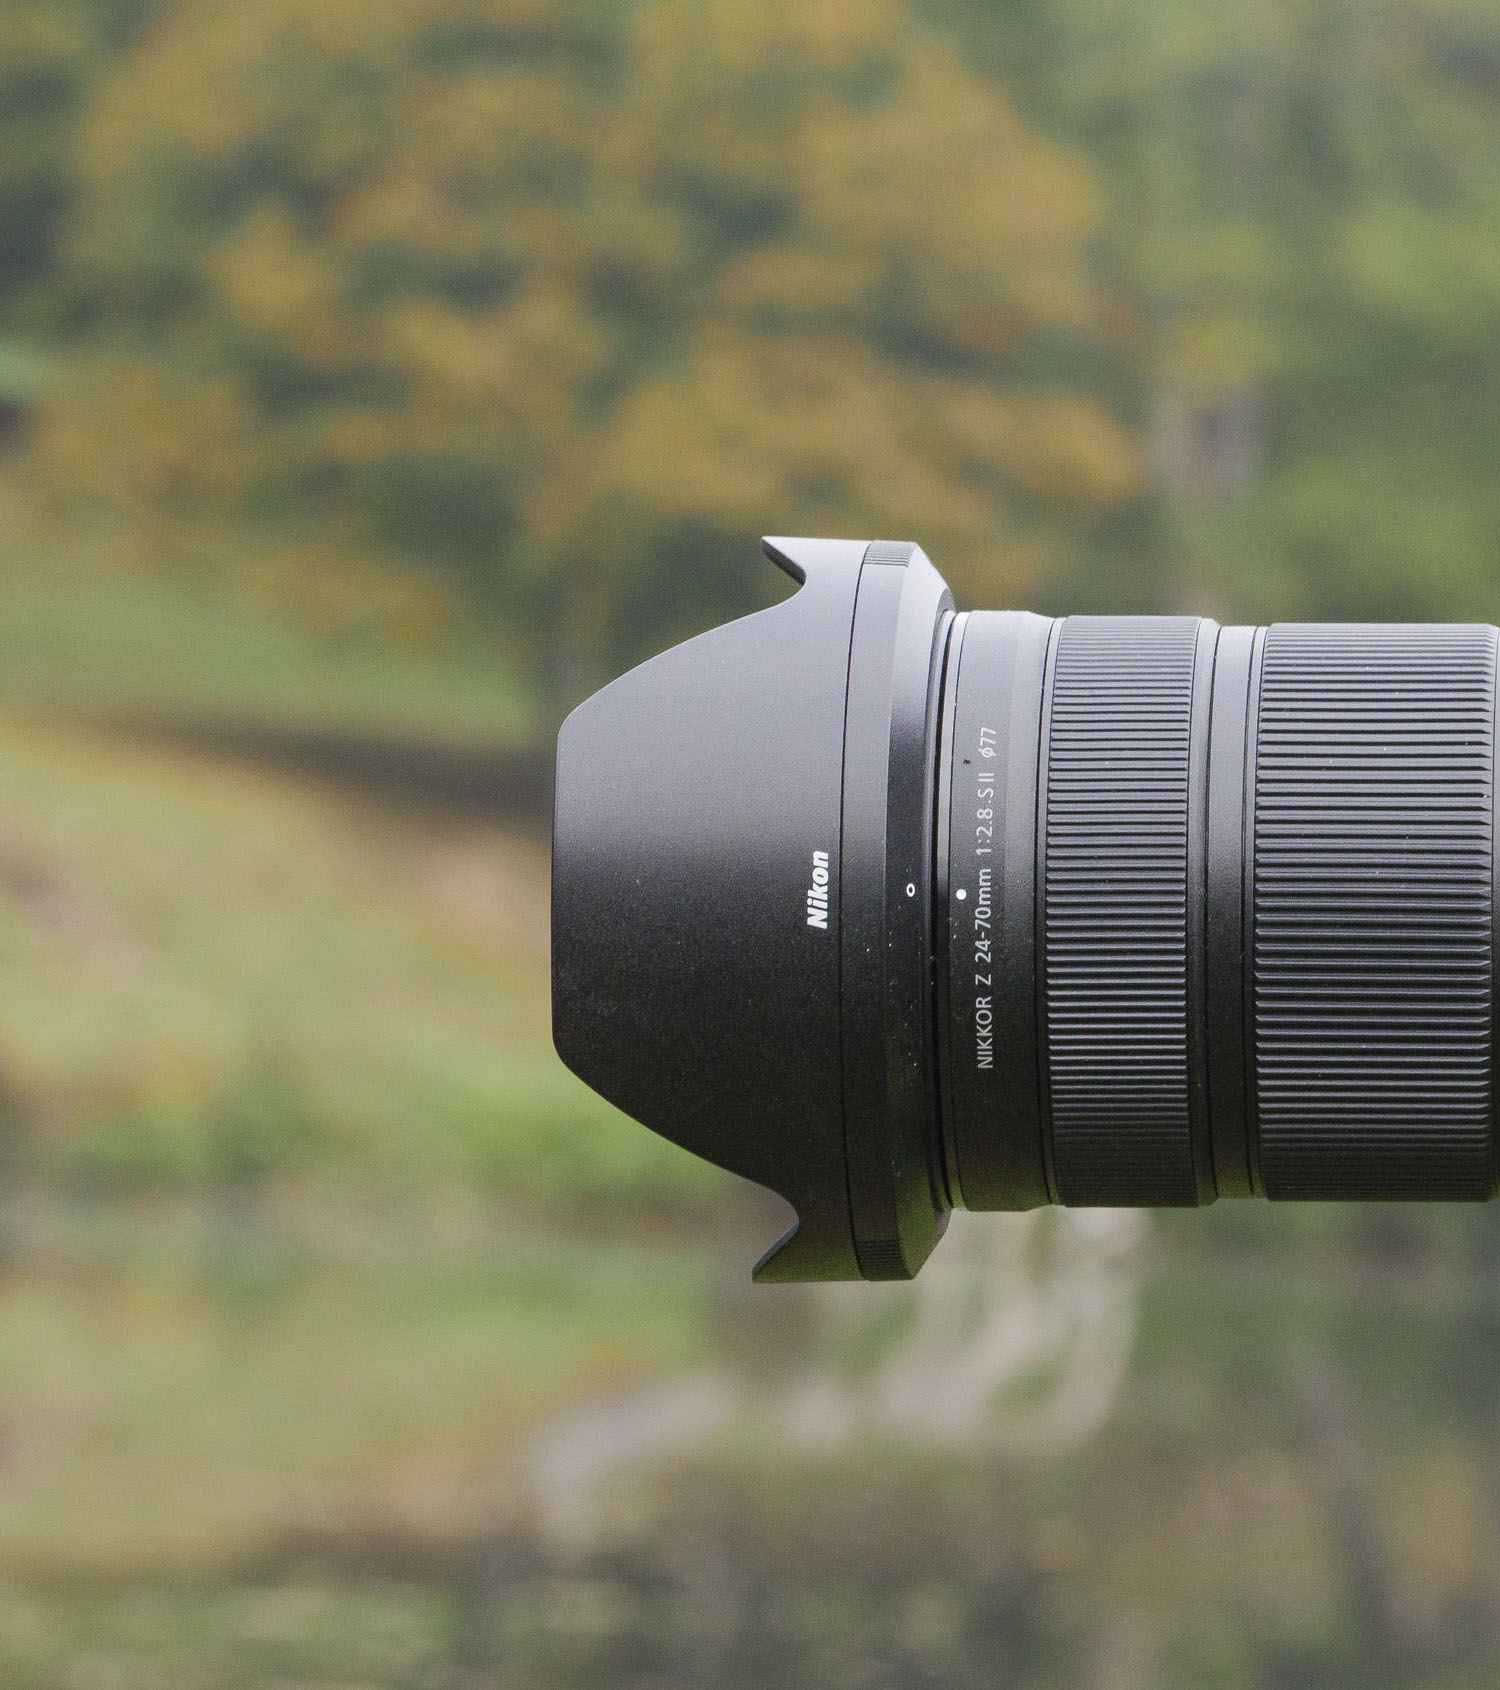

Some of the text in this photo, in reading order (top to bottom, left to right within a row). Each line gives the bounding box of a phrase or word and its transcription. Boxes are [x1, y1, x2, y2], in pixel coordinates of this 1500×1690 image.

[806, 850, 829, 930] Nikon
[974, 868, 992, 963] 24-70mm
[975, 973, 992, 986] Z
[976, 996, 994, 1070] NIKKOR
